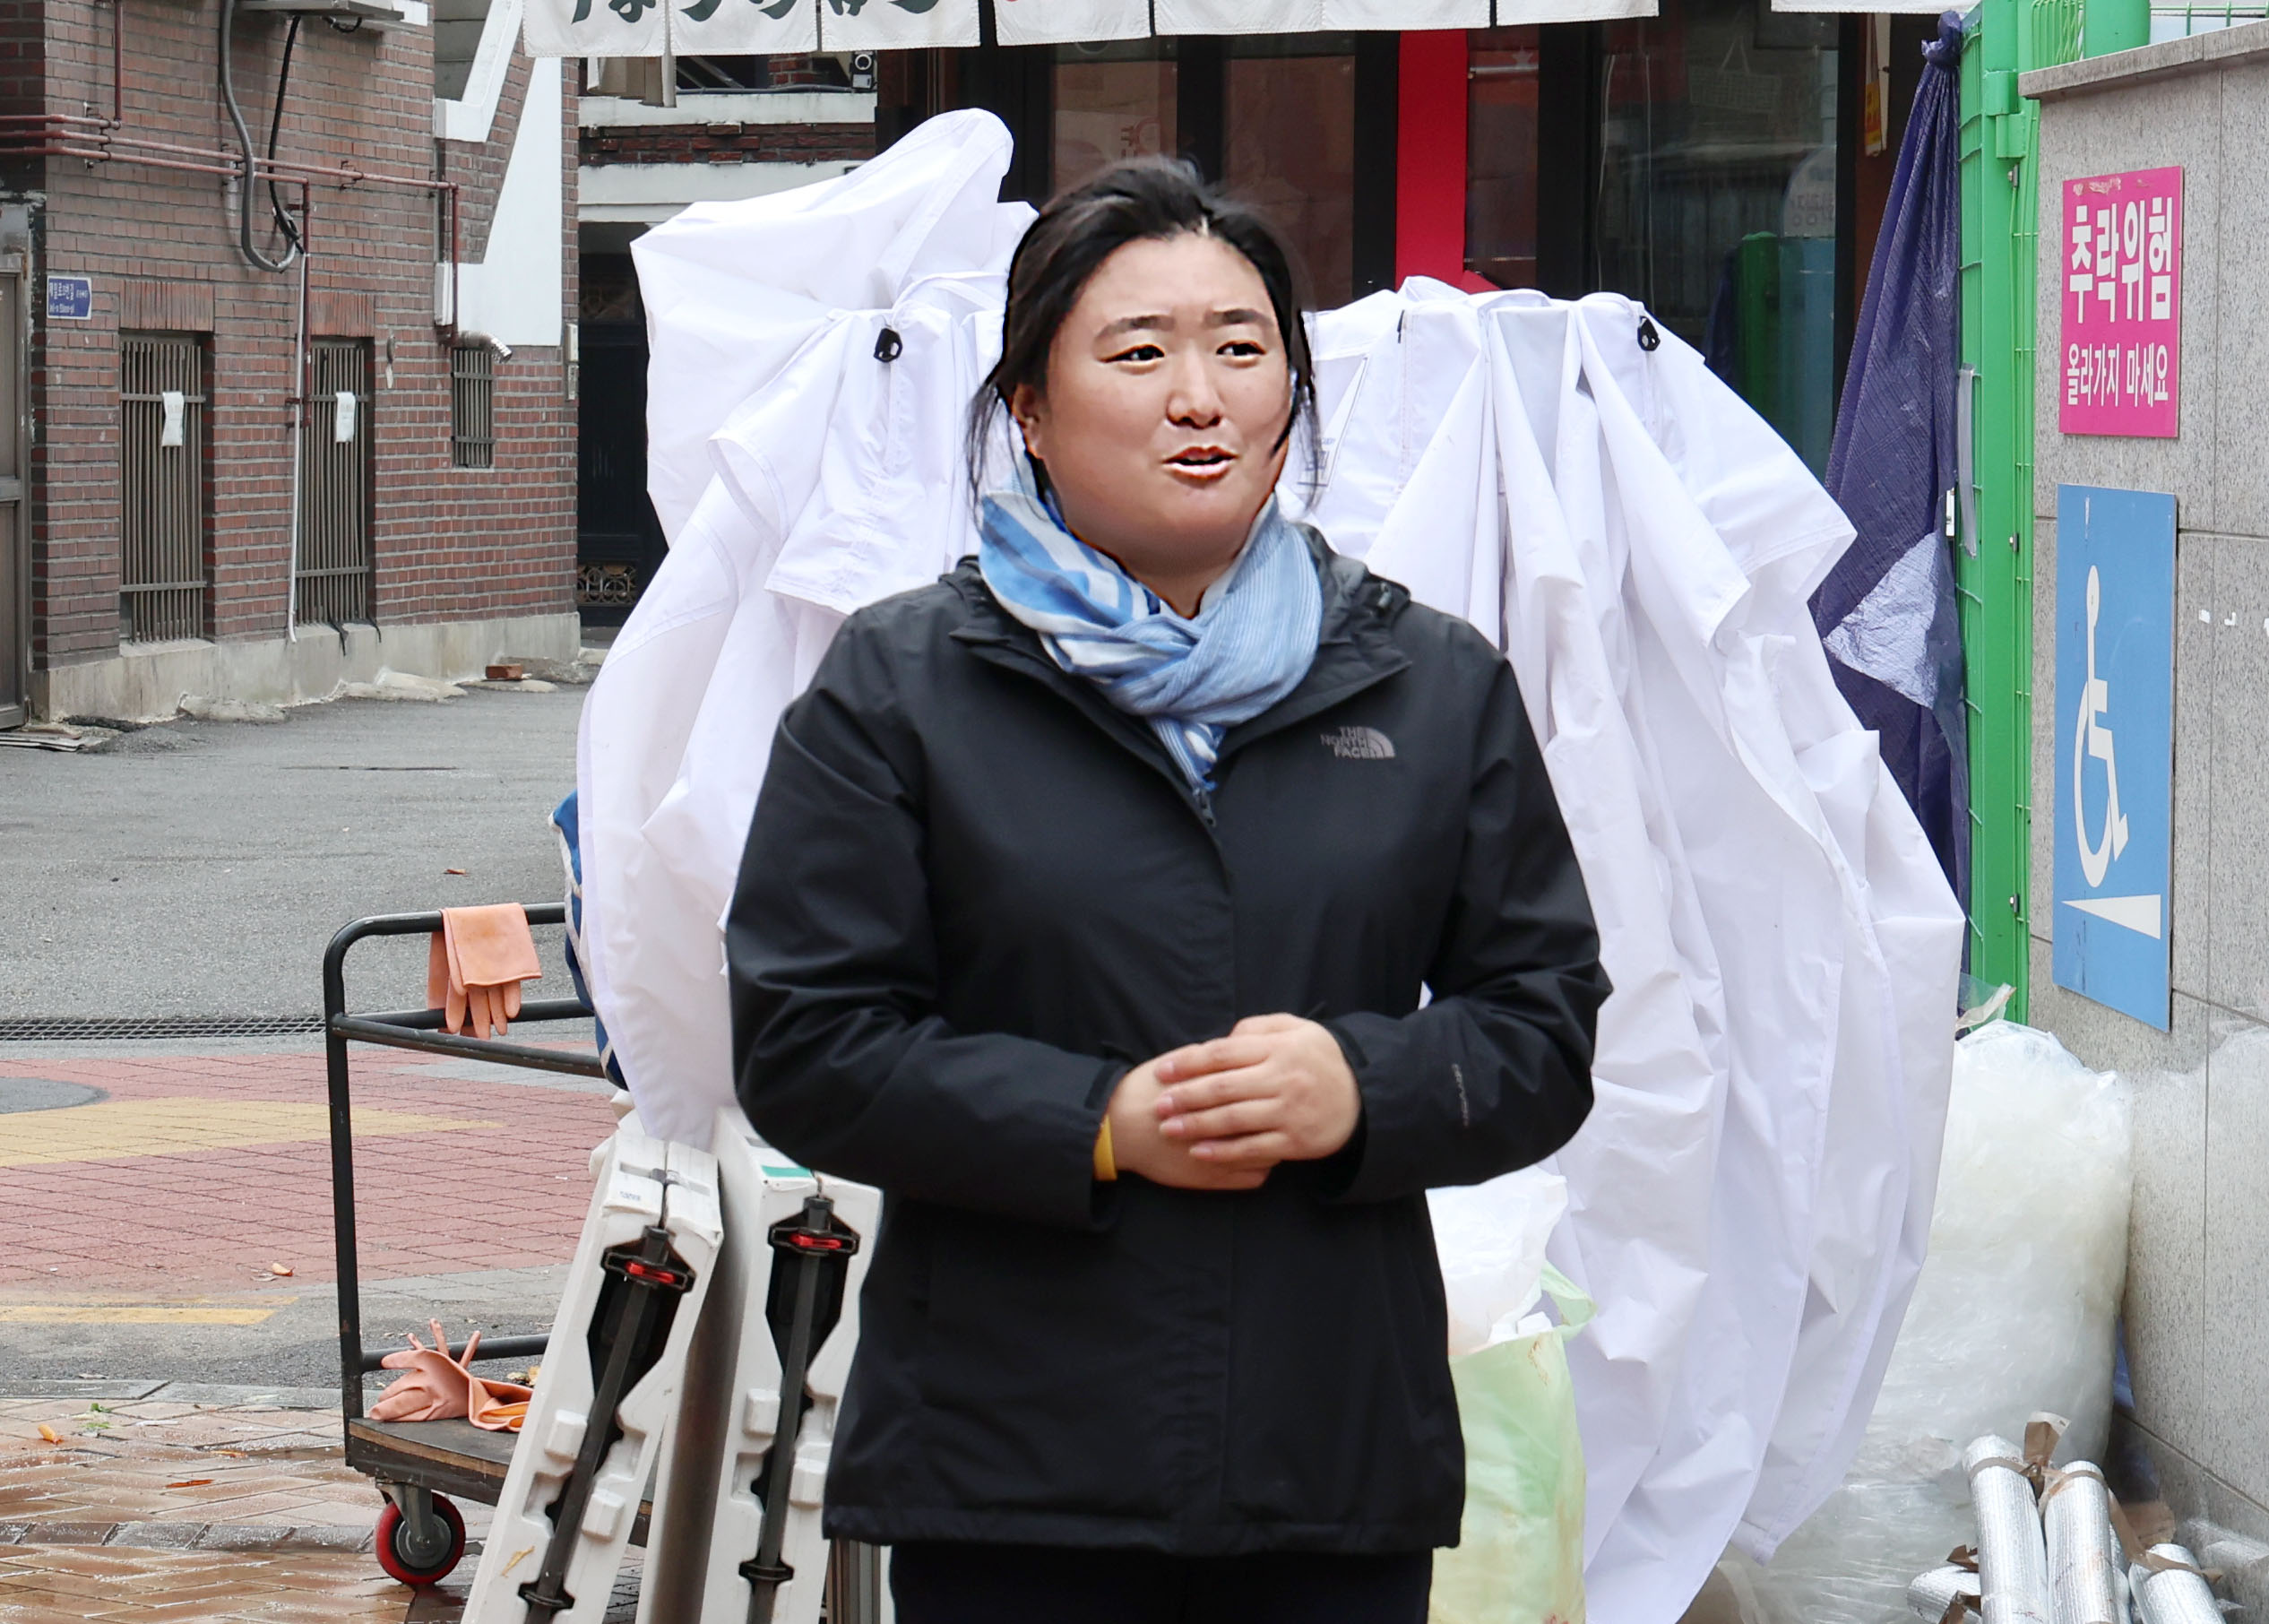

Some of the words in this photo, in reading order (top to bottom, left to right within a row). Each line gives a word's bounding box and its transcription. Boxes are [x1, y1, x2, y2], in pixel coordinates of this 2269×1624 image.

[2069, 196, 2173, 324] 추락위험
[2066, 343, 2120, 407] 올라가지
[2126, 342, 2169, 408] 마세요
[1339, 726, 1364, 737] THE
[1320, 734, 1368, 746] NORTH
[1333, 745, 1369, 758] FACE
